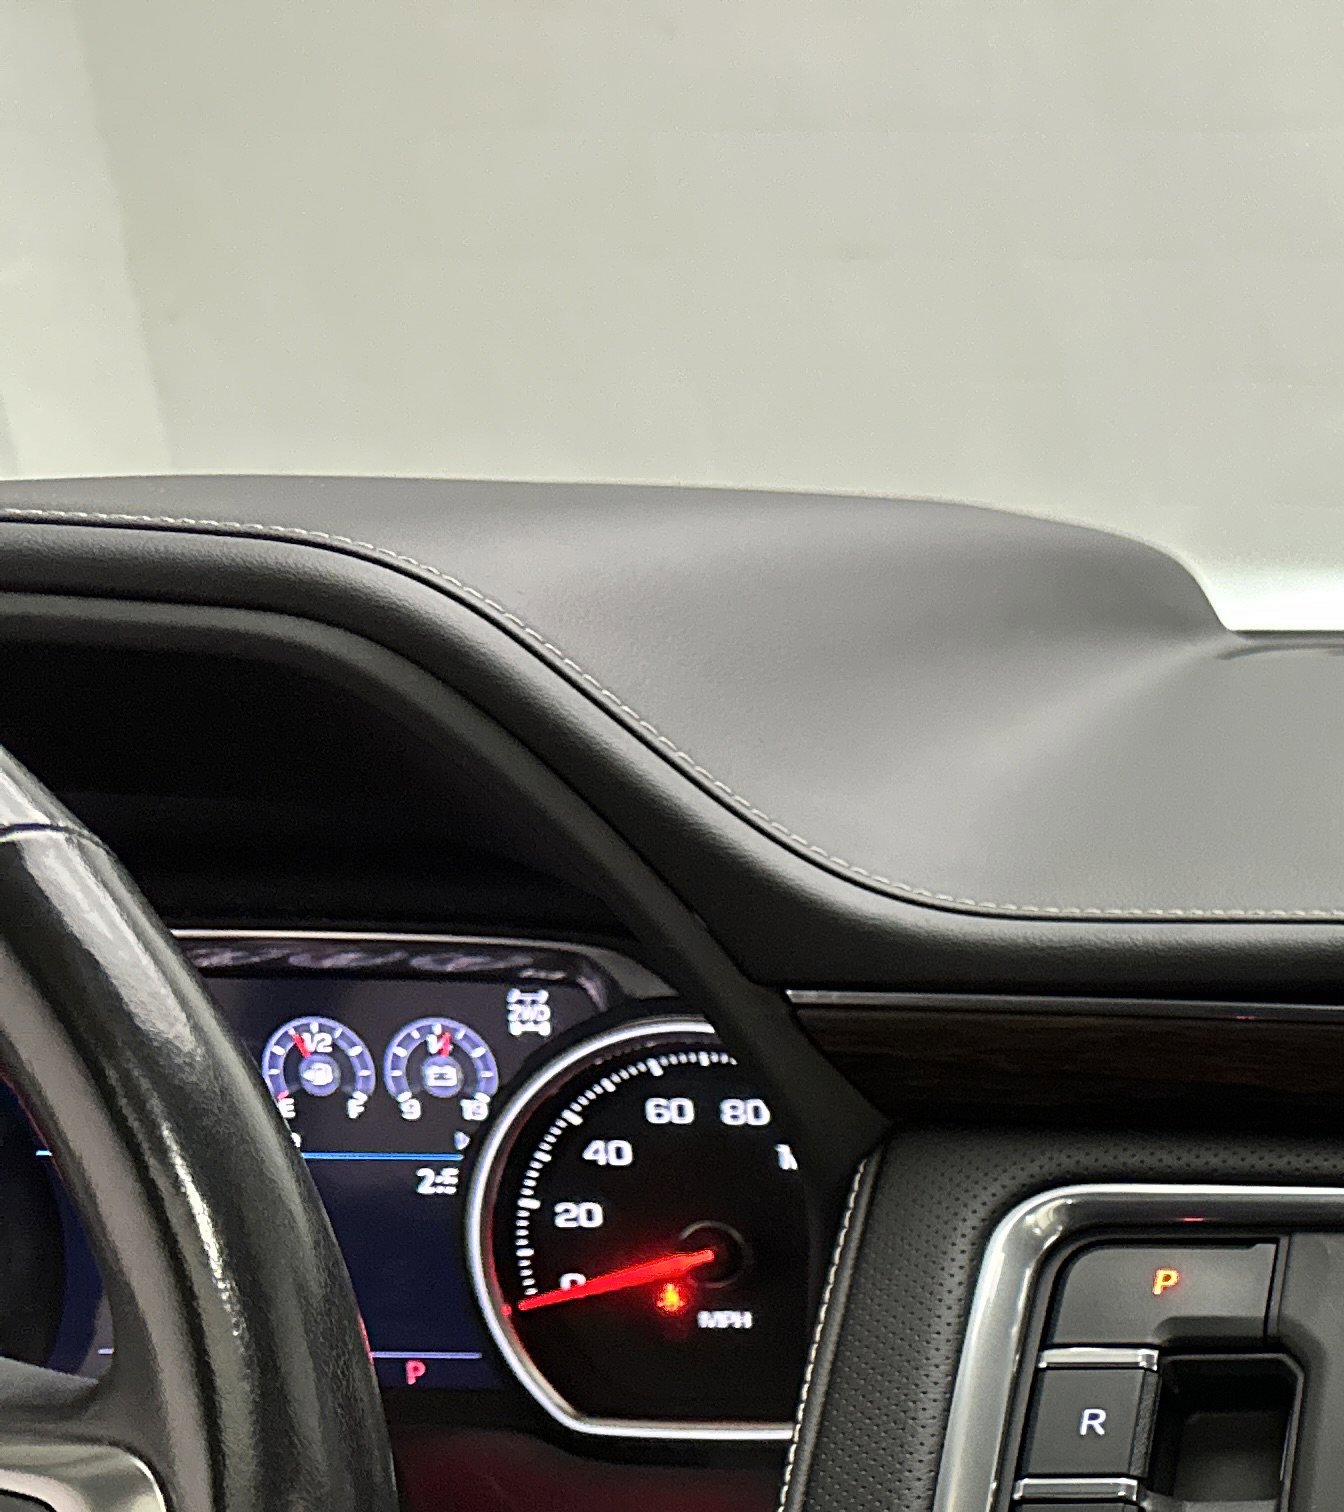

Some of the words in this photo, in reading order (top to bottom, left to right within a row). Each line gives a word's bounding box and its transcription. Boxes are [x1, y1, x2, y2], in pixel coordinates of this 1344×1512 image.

[645, 1097, 695, 1125] 60
[720, 1098, 771, 1126] 80
[582, 1139, 633, 1166] 40
[554, 1201, 604, 1228] 20
[1151, 1268, 1182, 1295] P
[405, 1359, 426, 1385] P
[1079, 1408, 1107, 1436] R
